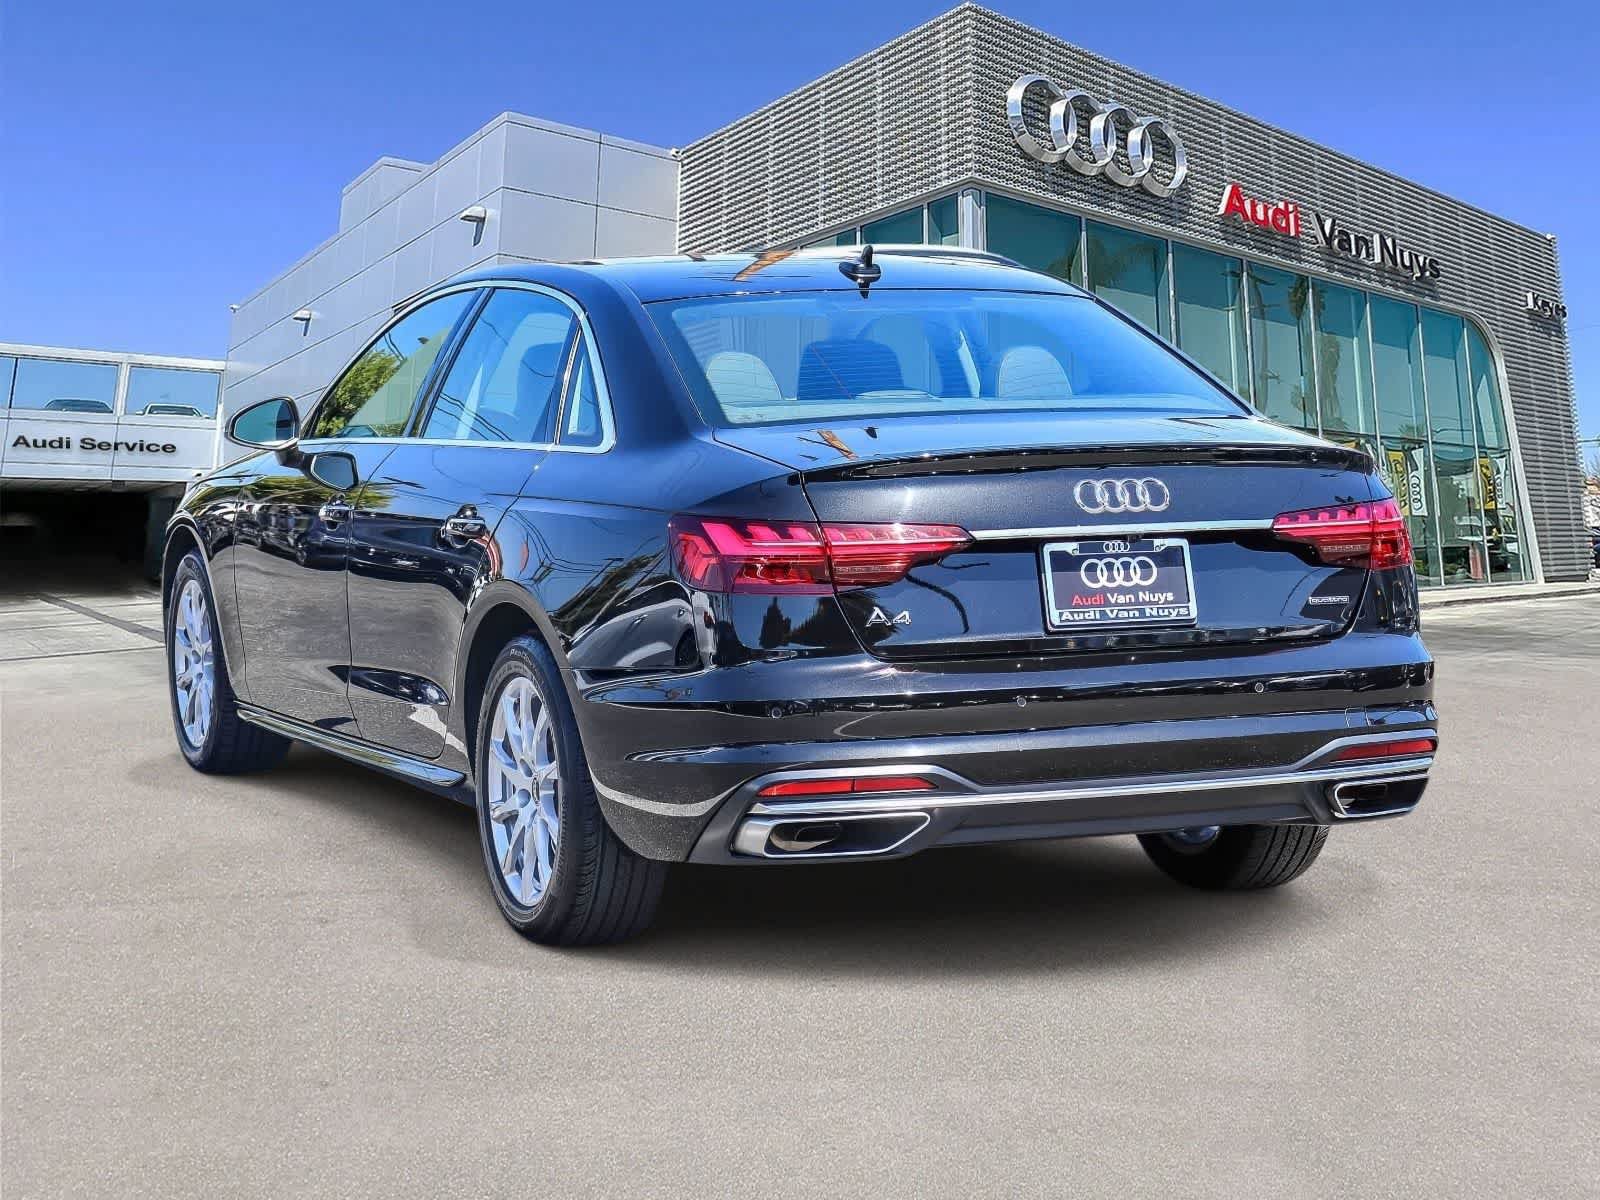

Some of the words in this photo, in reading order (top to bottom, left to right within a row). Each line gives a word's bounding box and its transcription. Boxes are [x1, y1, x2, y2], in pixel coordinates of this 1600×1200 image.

[1217, 182, 1301, 237] Audi
[1311, 212, 1371, 258] Van
[1374, 232, 1441, 280] Nuys
[1526, 291, 1568, 318] Keyes
[12, 435, 72, 449] Audi
[79, 437, 177, 453] Service
[1072, 594, 1105, 606] Audi
[1107, 592, 1135, 604] Van
[1138, 591, 1174, 605] Nuys
[865, 606, 912, 627] A4
[1060, 609, 1100, 621] Audi
[1105, 609, 1140, 619] Van
[1145, 606, 1189, 618] Nuys
